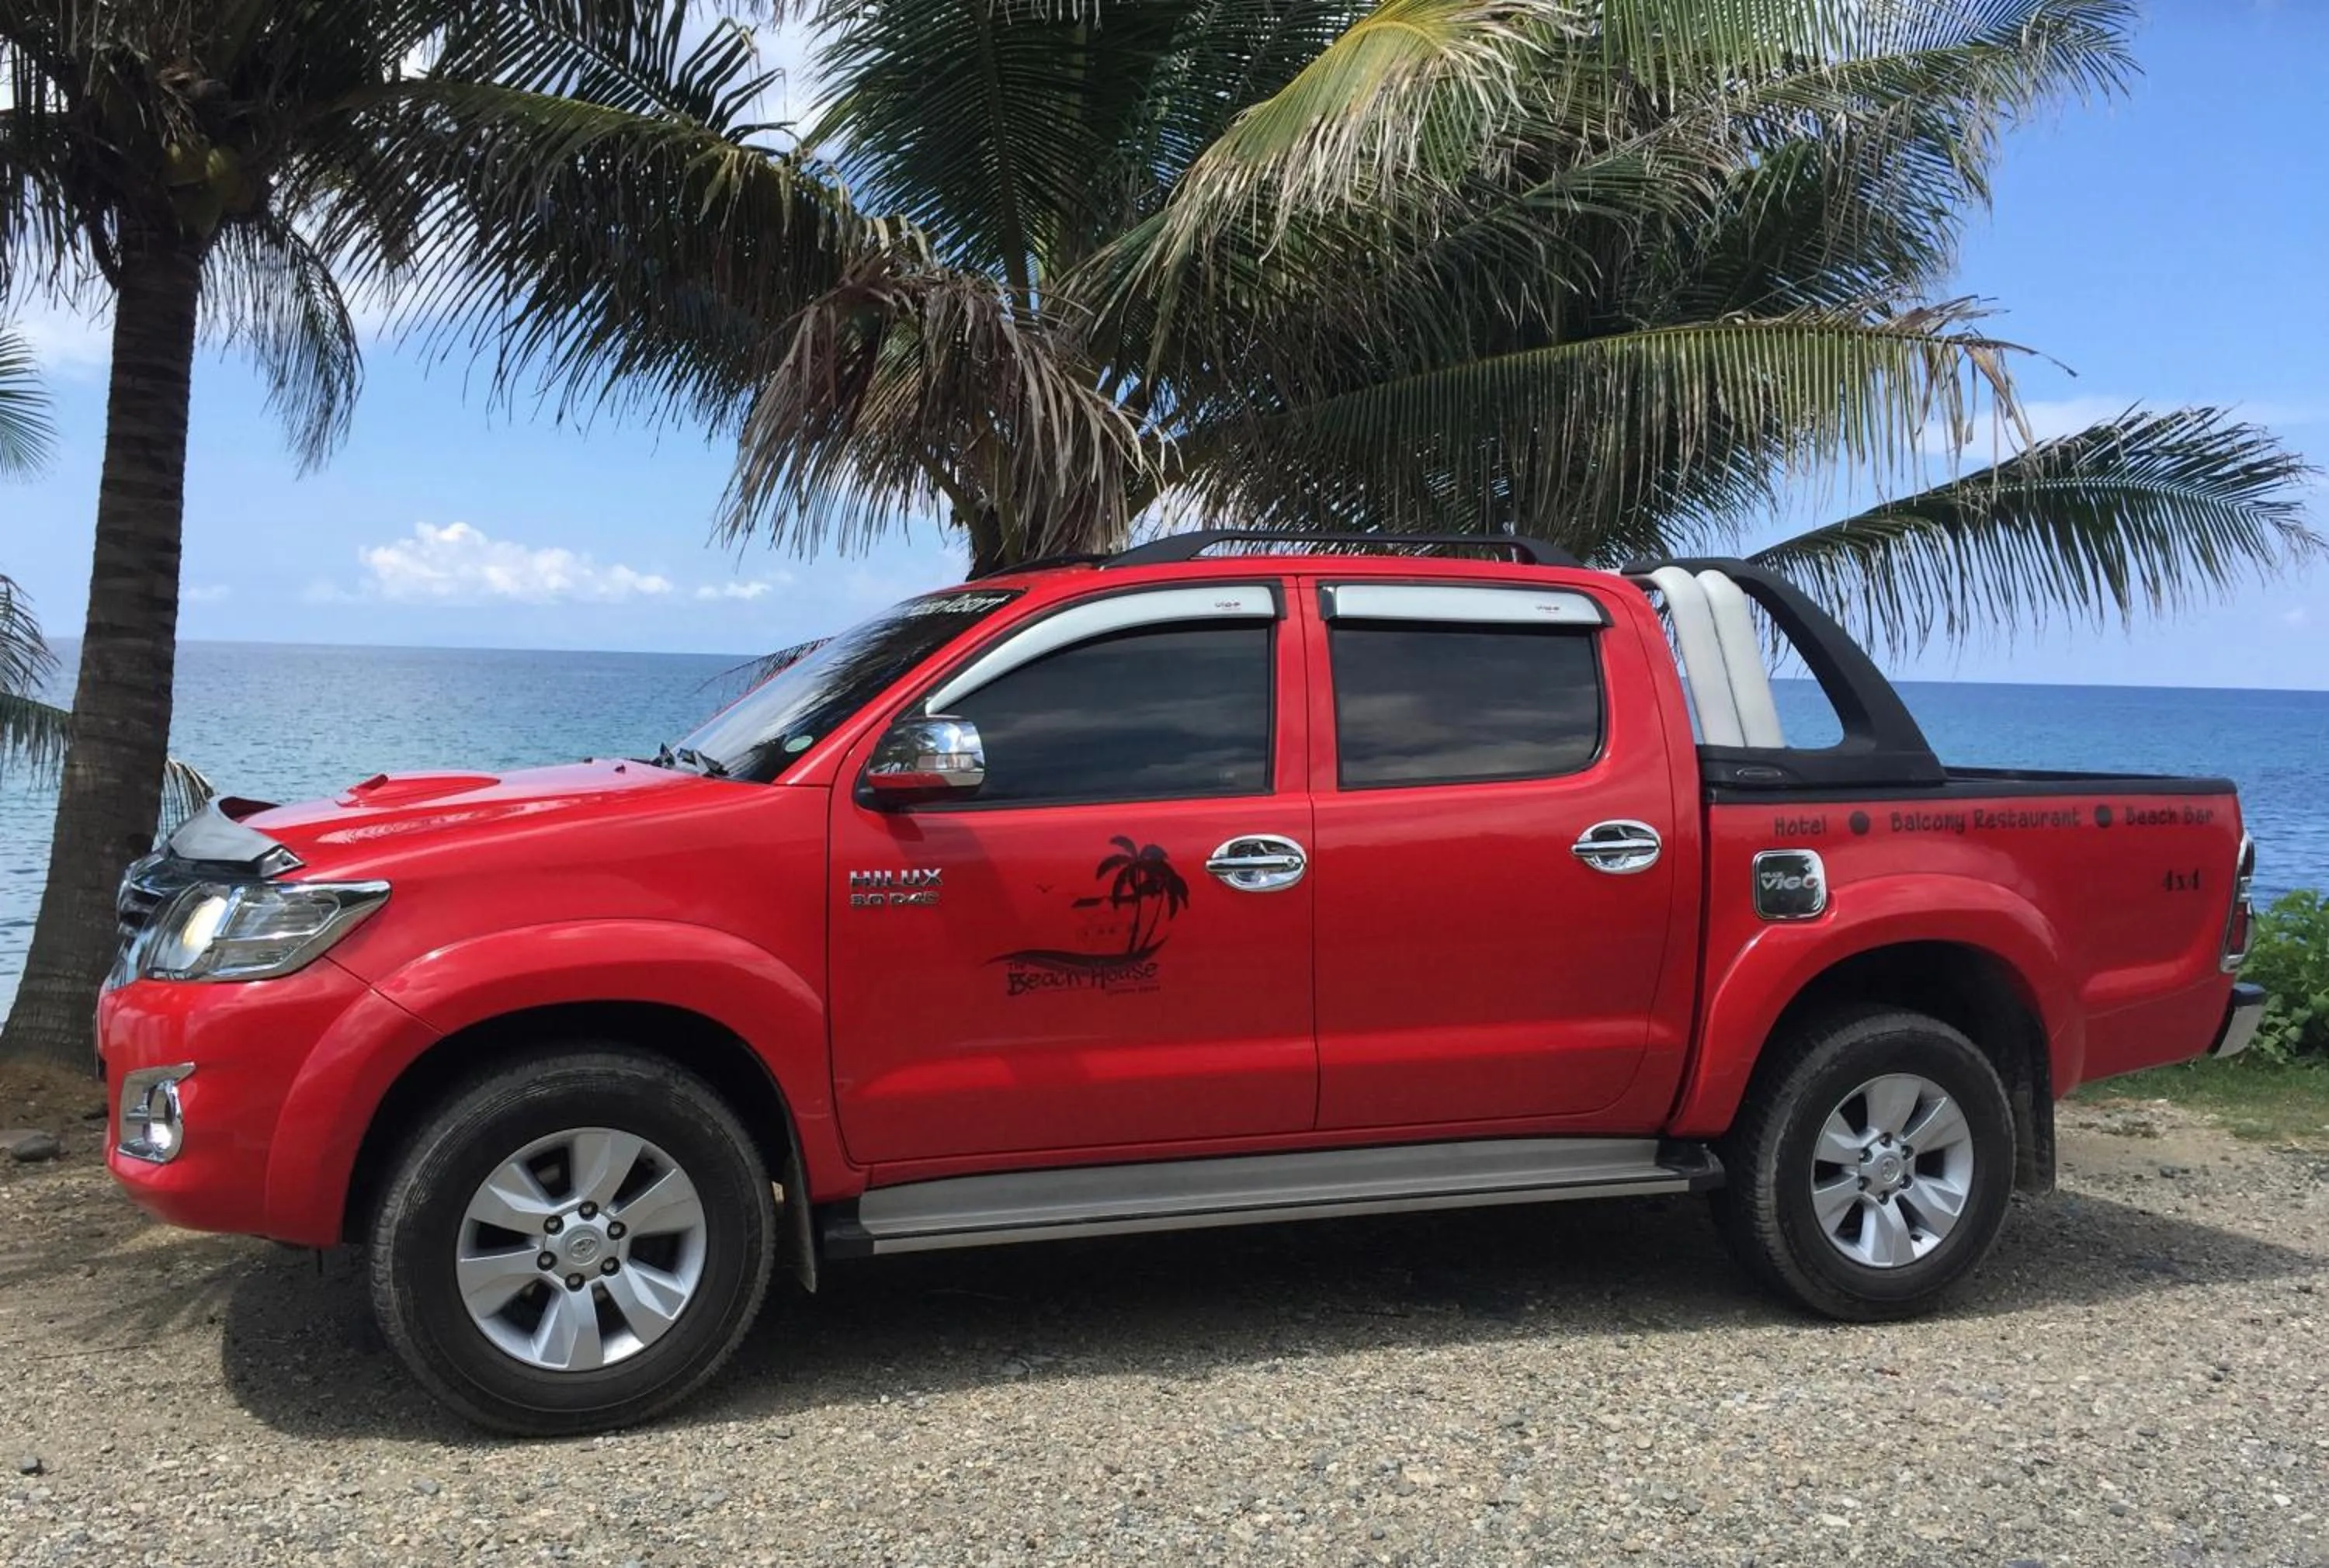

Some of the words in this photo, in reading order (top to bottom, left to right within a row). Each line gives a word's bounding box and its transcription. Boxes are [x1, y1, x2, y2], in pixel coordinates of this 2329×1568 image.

[1774, 817, 1827, 836] Hotel
[1890, 812, 1966, 834] Balcony
[1973, 808, 2080, 829] Restaurant
[2125, 807, 2177, 824] Beach
[2184, 805, 2214, 824] Bar
[849, 868, 943, 886] HILUX
[1761, 874, 1819, 890] VIGO
[2161, 868, 2199, 893] 4x4
[1008, 969, 1081, 996] Beach
[1091, 961, 1159, 989] House
